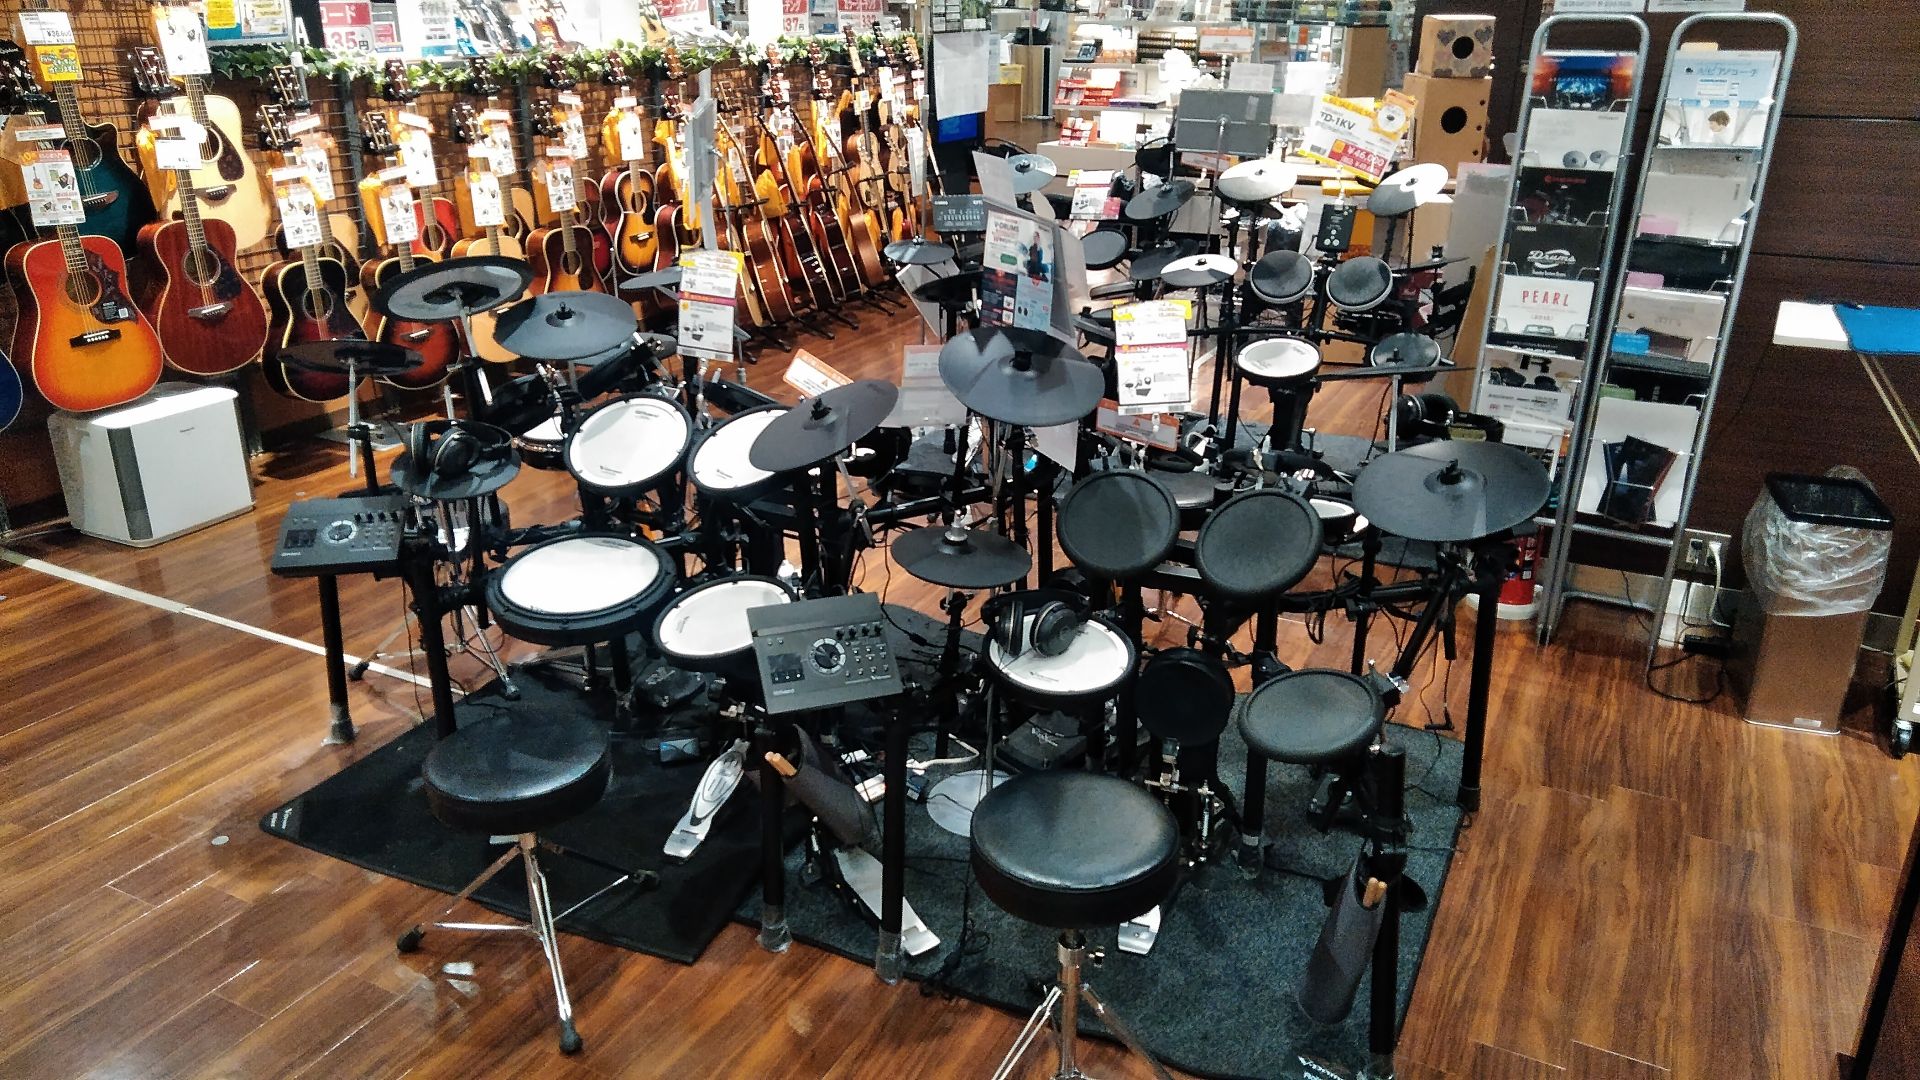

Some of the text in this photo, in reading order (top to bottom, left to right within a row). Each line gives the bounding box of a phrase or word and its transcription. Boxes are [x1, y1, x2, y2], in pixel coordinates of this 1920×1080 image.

[1320, 111, 1356, 131] TD-1KV
[1526, 249, 1577, 265] Drums
[1522, 290, 1569, 307] PEARL
